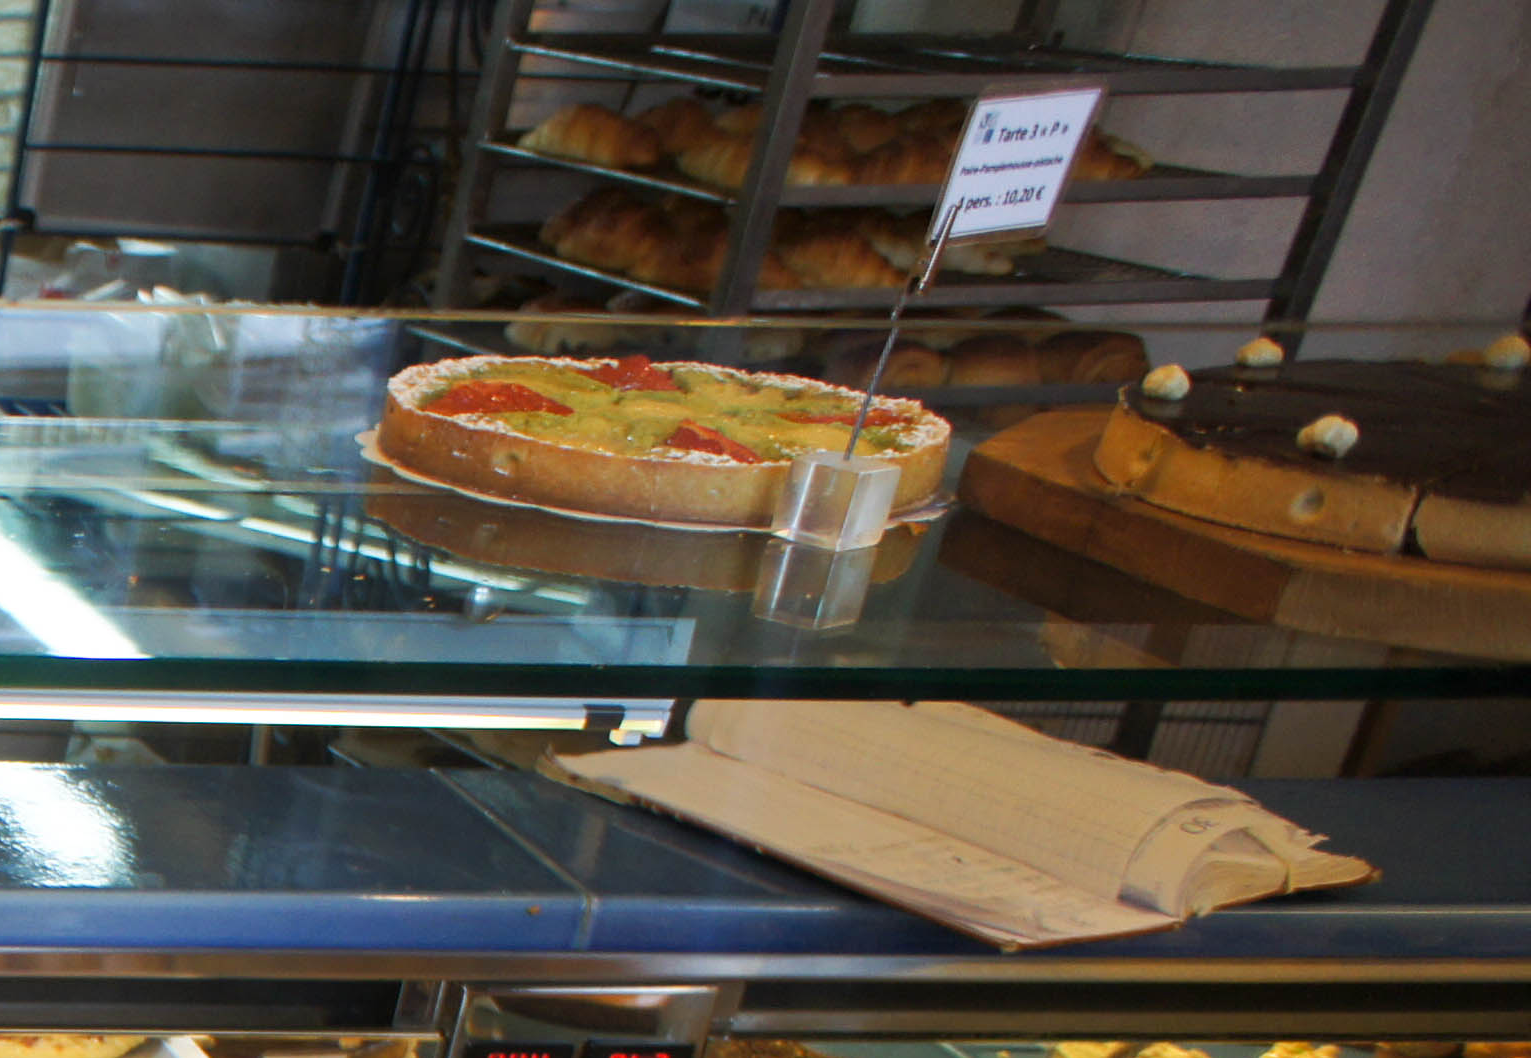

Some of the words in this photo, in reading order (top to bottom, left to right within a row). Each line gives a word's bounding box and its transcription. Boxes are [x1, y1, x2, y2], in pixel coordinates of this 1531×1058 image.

[998, 127, 1029, 144] Tarte
[1029, 123, 1039, 140] 3
[1049, 121, 1061, 137] P
[965, 196, 992, 213] pers.
[1002, 187, 1035, 206] 10,20
[1035, 185, 1046, 201] €
